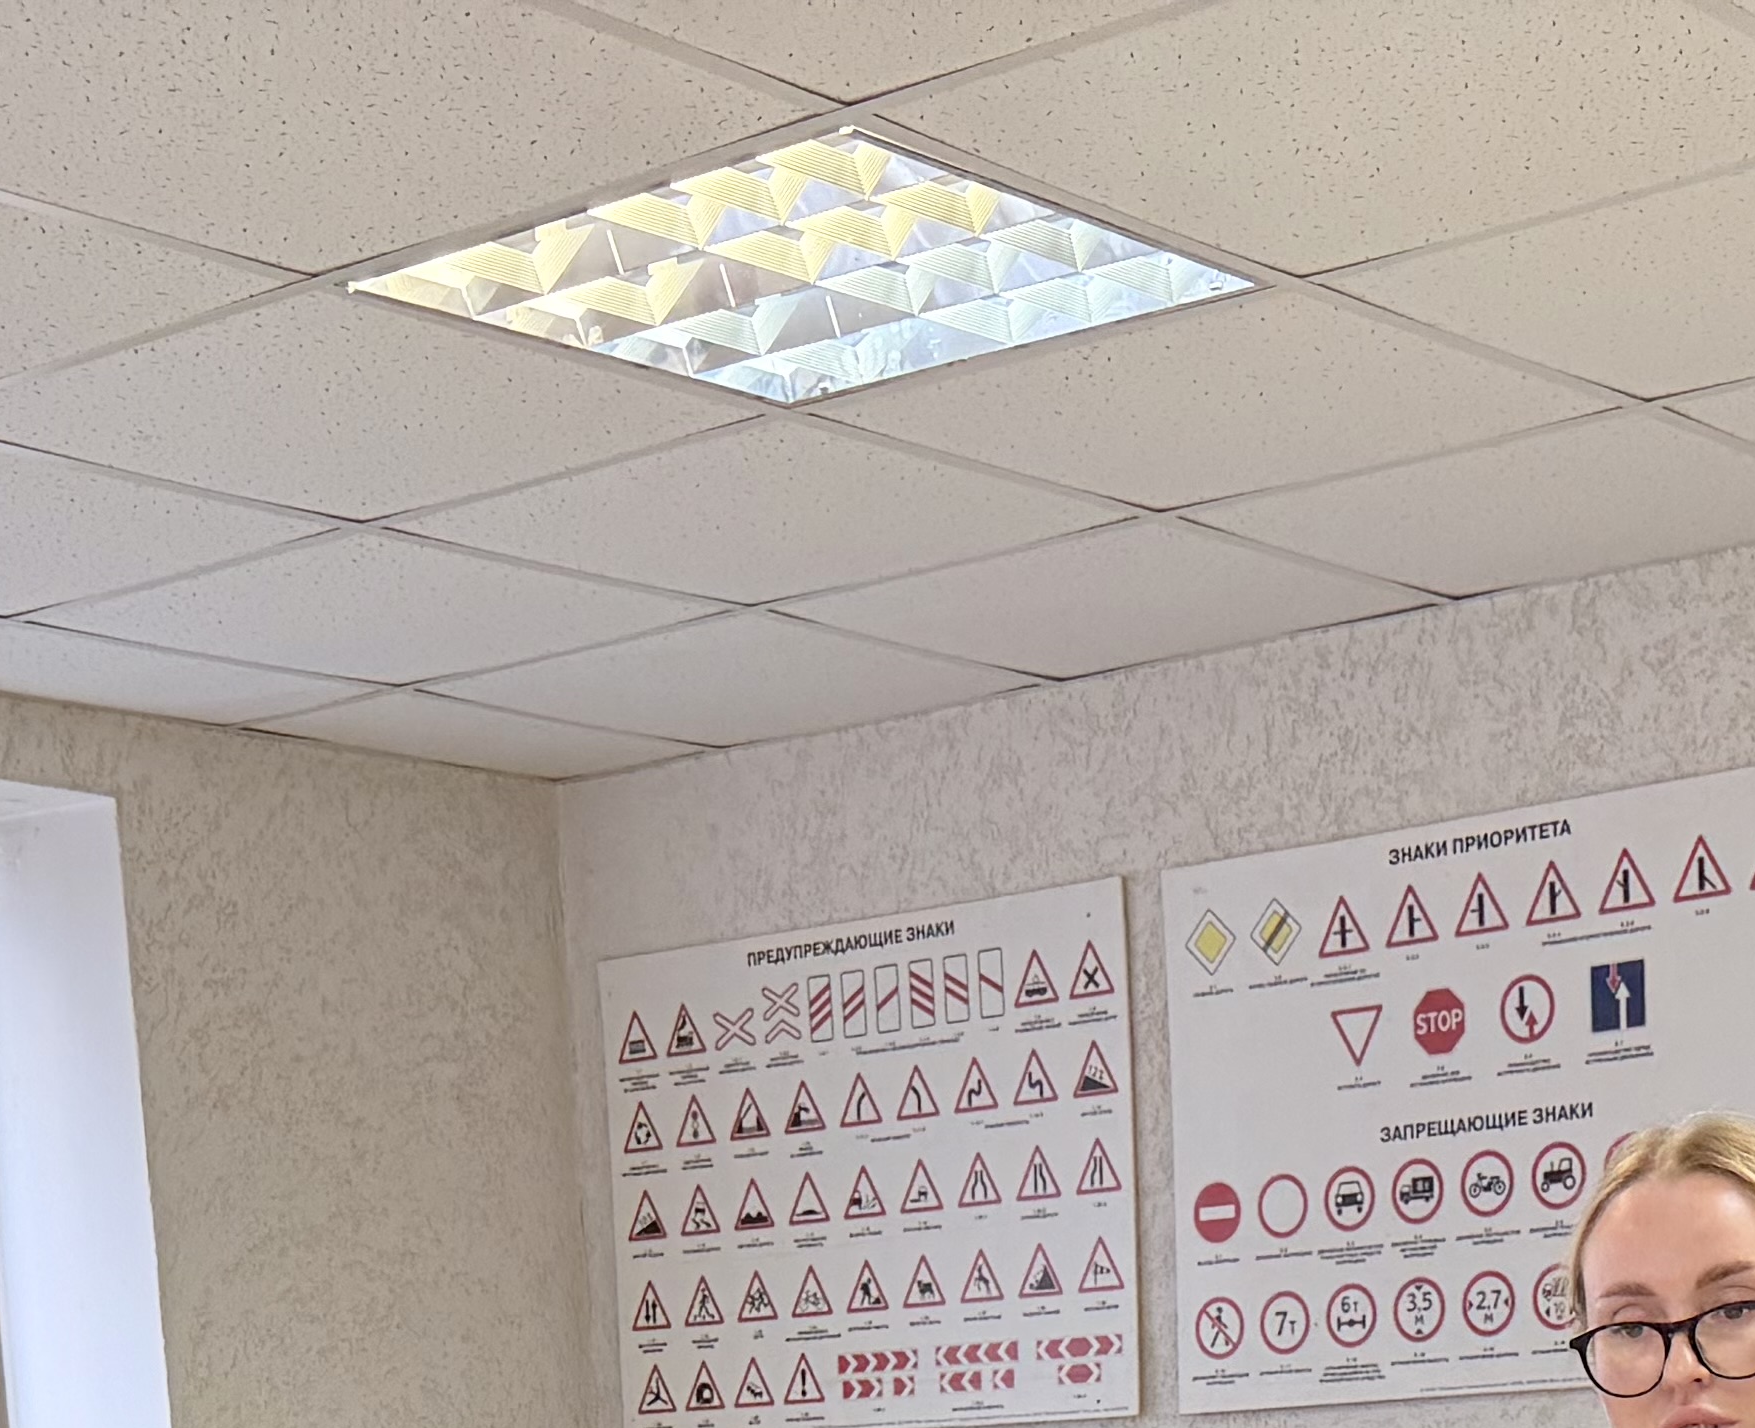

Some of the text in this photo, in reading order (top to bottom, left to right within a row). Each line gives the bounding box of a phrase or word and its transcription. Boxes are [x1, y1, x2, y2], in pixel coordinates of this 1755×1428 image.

[1388, 819, 1573, 865] ЗНАКИ ПРИОРИТЕТА
[747, 921, 956, 967] ПРЕДУПРЕЖДАЮЩИЕ ЗНАКИ
[1416, 1006, 1463, 1034] STOP
[1380, 1101, 1594, 1143] ЗАПРЕЩАЮЩИЕ ЗНАКИ
